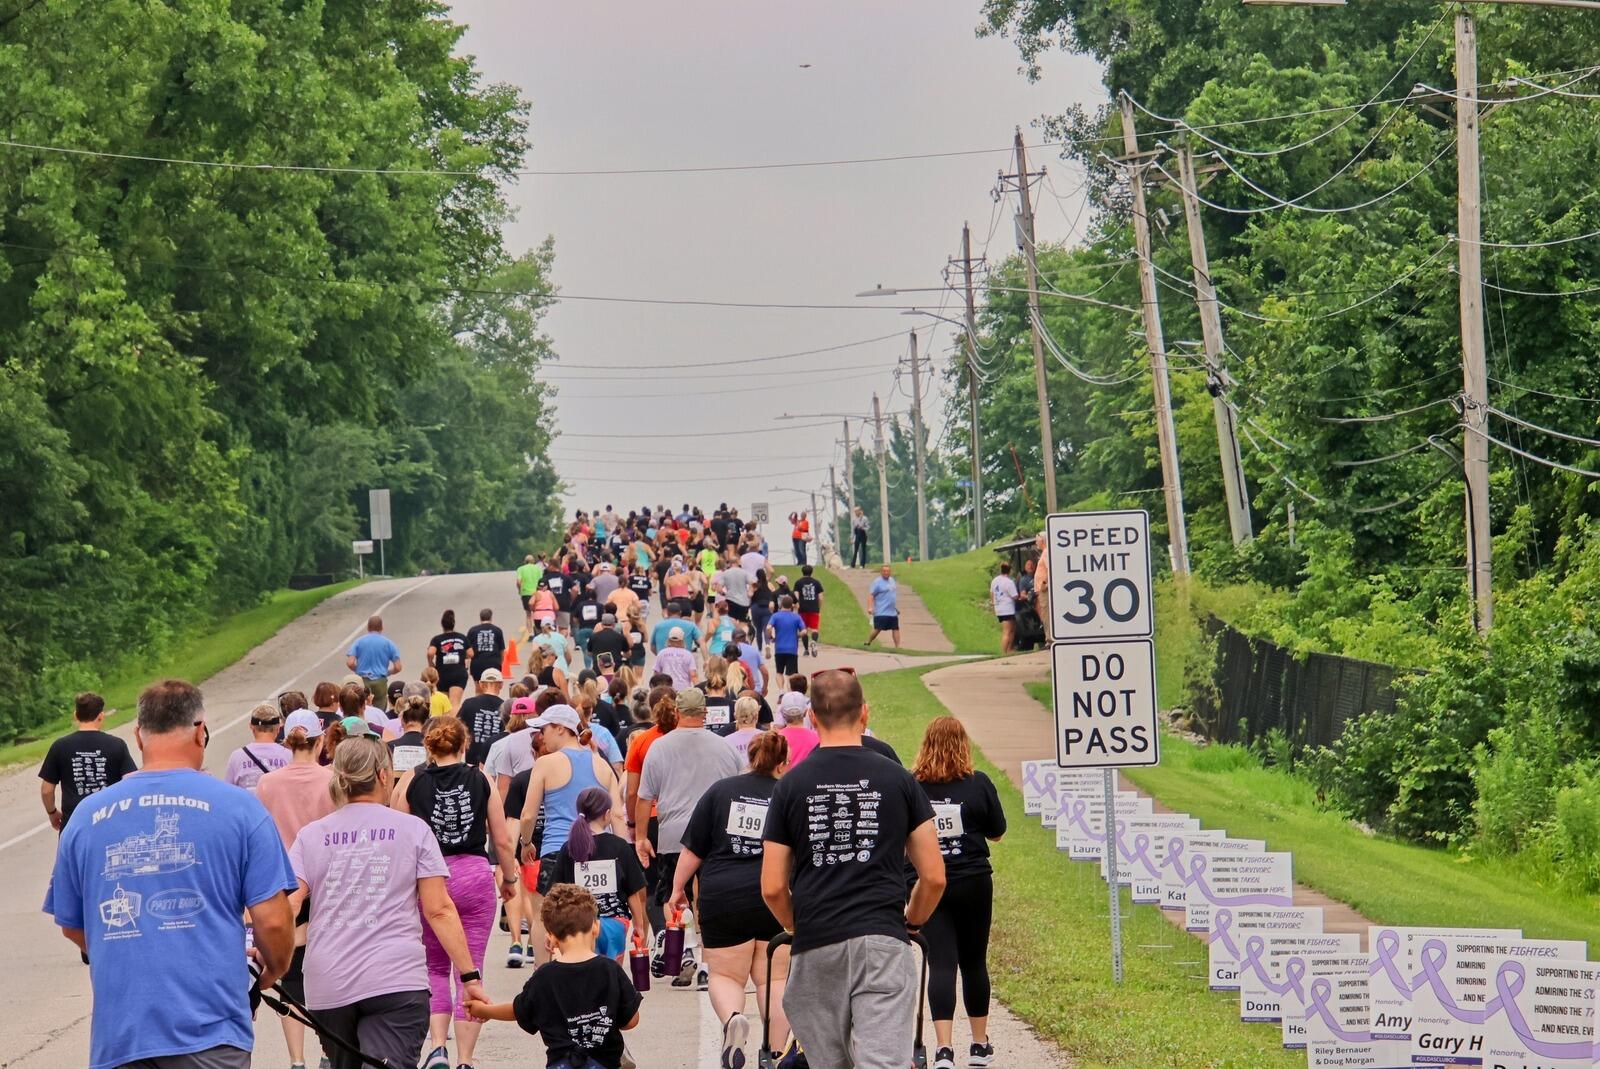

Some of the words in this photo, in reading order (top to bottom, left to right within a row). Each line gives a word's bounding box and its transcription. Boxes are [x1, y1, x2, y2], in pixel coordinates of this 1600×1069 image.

[1057, 526, 1139, 548] SPEED
[1066, 552, 1131, 573] LIMIT
[1062, 577, 1140, 624] 30
[1081, 653, 1125, 682] DO
[1072, 689, 1136, 718] NOT
[1064, 725, 1149, 755] PASS
[92, 798, 133, 825] M/V
[138, 794, 210, 812] Clinton
[737, 815, 762, 831] 199
[1073, 845, 1101, 853] Laure
[584, 873, 608, 887] 298
[1168, 890, 1186, 901] Kat
[1456, 944, 1494, 954] SUPPORTING
[1496, 946, 1507, 954] THE
[1456, 961, 1485, 970] ADMIRING
[1216, 968, 1239, 979] Car
[1536, 968, 1578, 979] SUPPORTING
[1581, 970, 1593, 980] THE
[1456, 977, 1486, 986] HONORING
[1535, 986, 1567, 997] ADMIRING
[1569, 988, 1582, 998] THE
[1463, 994, 1476, 1002] AND
[1246, 1001, 1280, 1012] Donn
[1534, 1005, 1568, 1015] HONORING
[1569, 1006, 1582, 1016] THE
[1375, 1013, 1412, 1031] Amy
[1541, 1024, 1555, 1033] AND
[1557, 1025, 1581, 1035] NEVER,
[1418, 1033, 1464, 1054] Gary
[1469, 1035, 1484, 1051] H
[1315, 1047, 1334, 1055] Riley
[1490, 1049, 1527, 1059] Honoring:
[1323, 1058, 1343, 1066] Doug
[1345, 1057, 1375, 1066] Morgan
